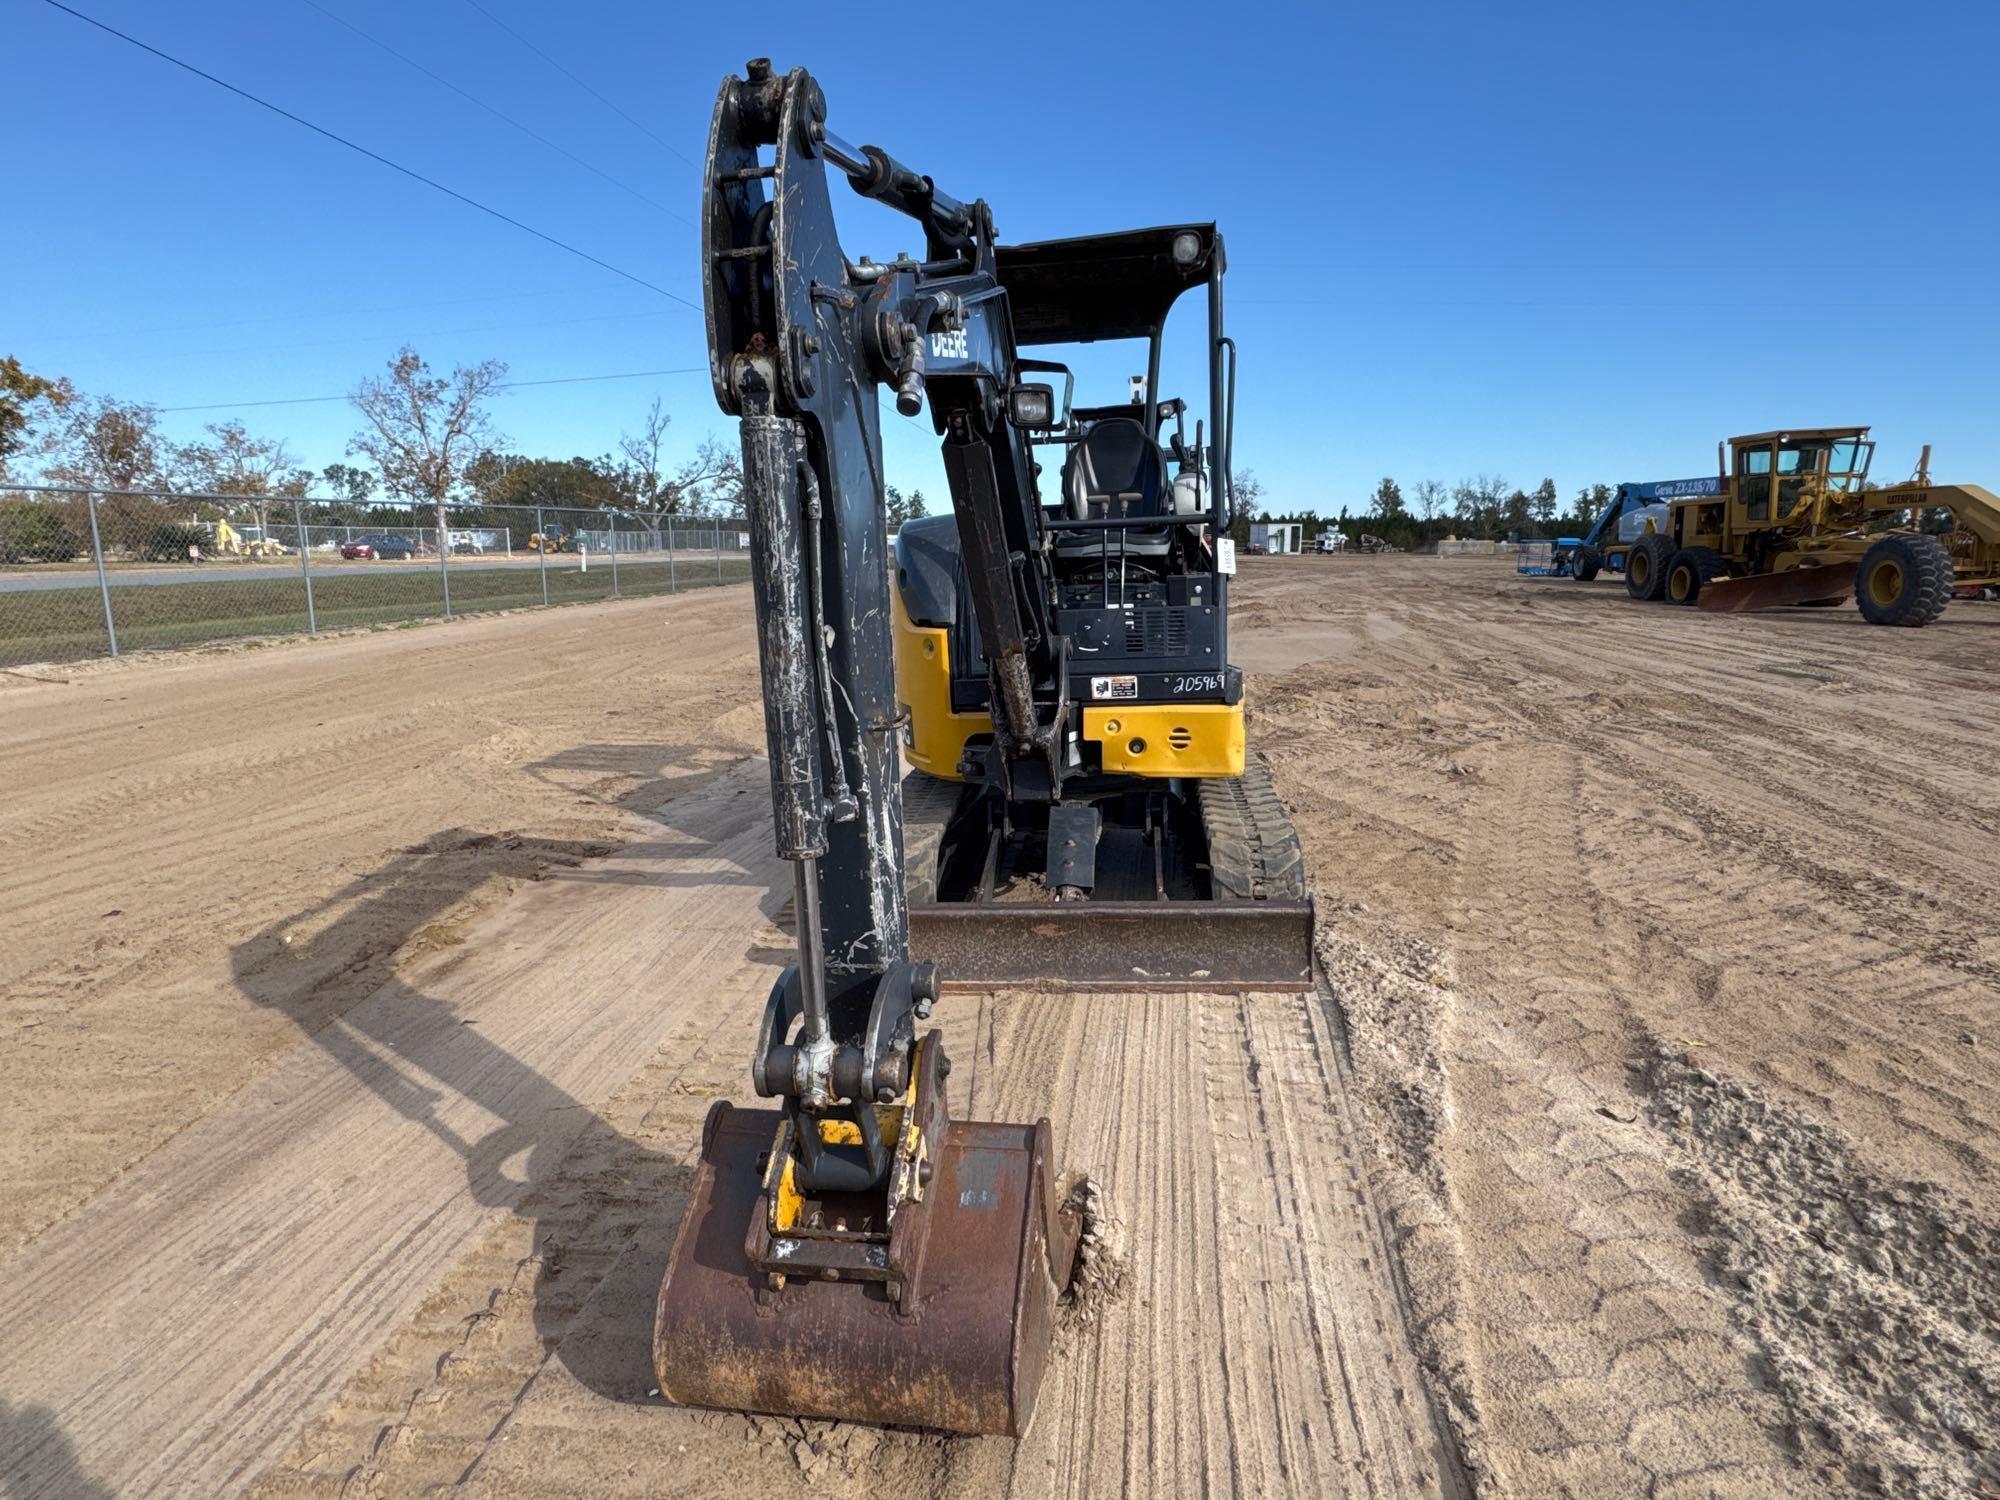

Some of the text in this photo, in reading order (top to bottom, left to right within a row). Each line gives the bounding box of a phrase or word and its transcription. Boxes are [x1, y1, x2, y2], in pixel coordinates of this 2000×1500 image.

[932, 328, 969, 359] DEERE
[1887, 493, 1928, 504] CATERPILLAR
[1173, 675, 1225, 693] 205969
